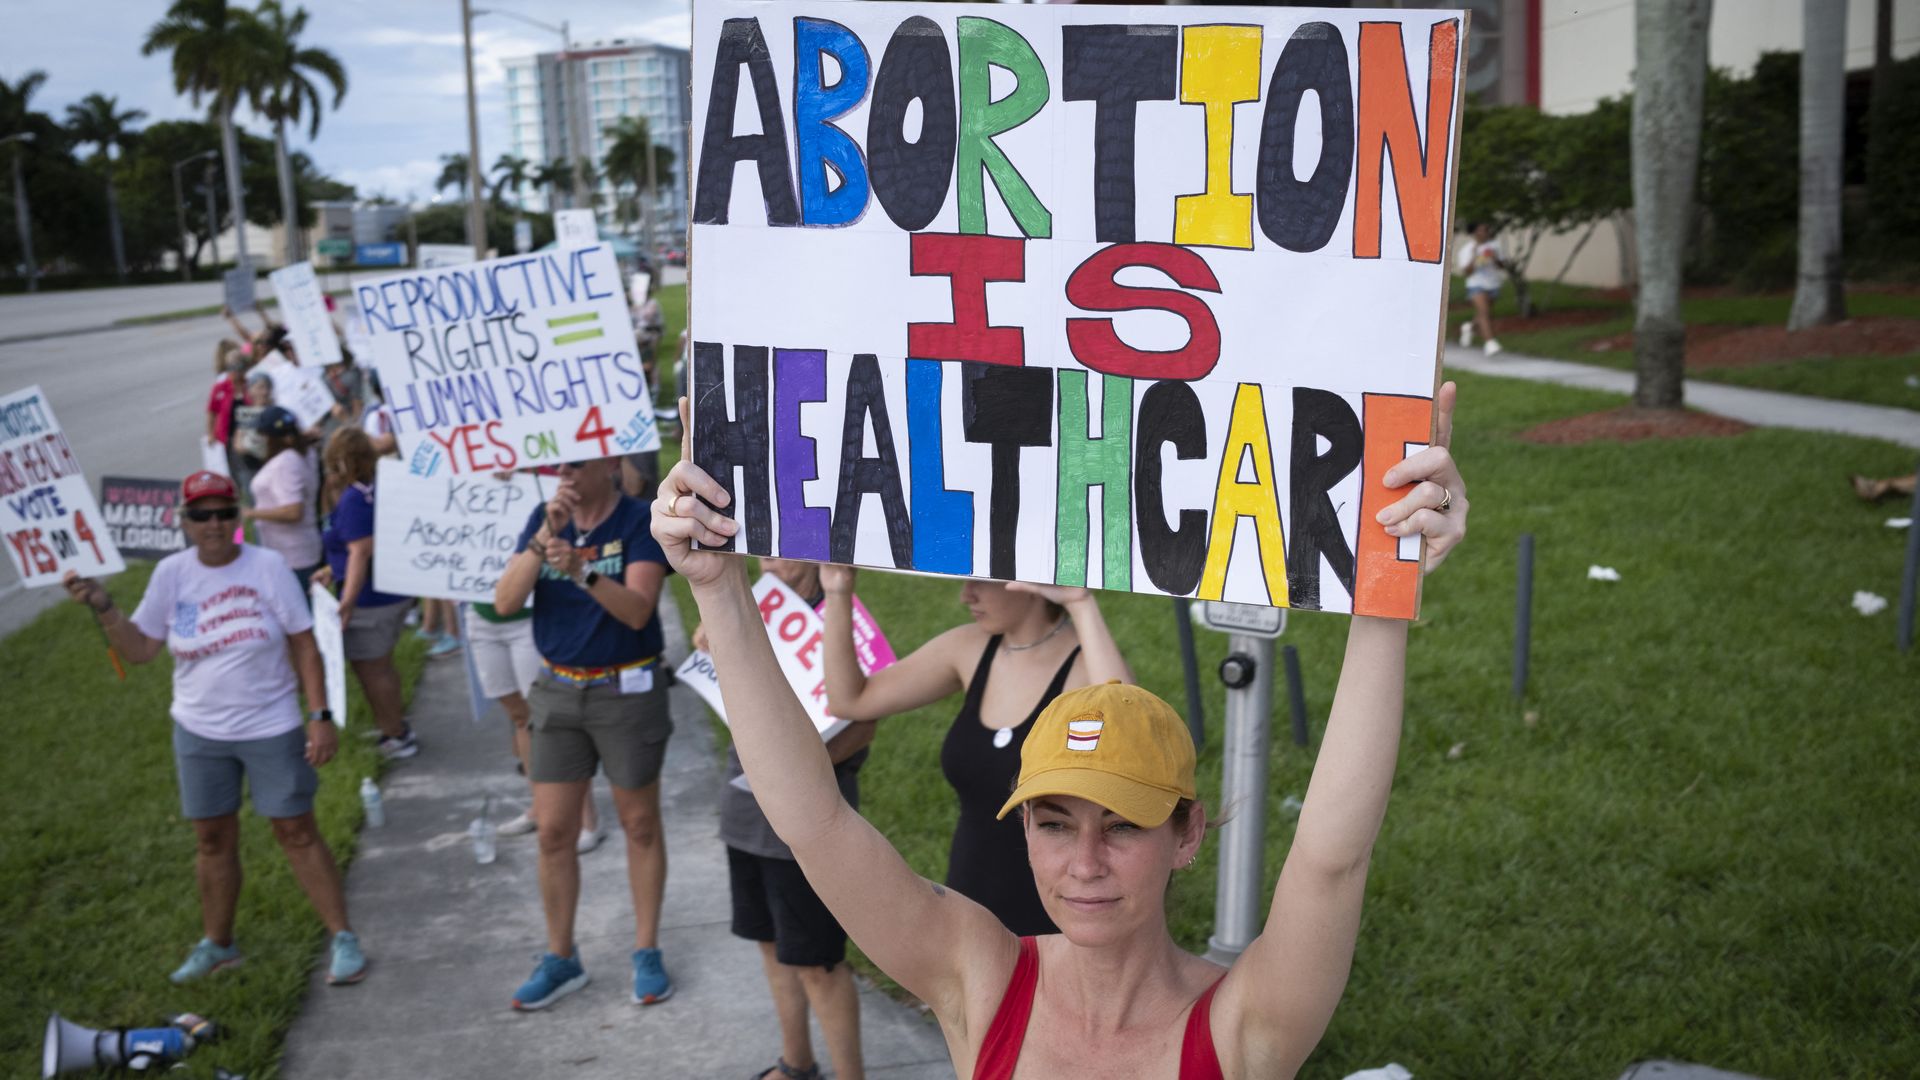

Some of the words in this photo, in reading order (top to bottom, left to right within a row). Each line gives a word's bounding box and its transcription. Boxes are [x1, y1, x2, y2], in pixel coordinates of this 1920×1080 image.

[692, 14, 1460, 264] ABORTION
[358, 246, 613, 335] REPRODUCTIVE
[907, 232, 1222, 381] IS
[404, 312, 540, 380] RIGHTS
[385, 370, 503, 434] HUMAN
[506, 352, 643, 417] RIGHTS
[430, 421, 517, 474] YES
[524, 430, 559, 459] ON
[575, 406, 615, 457] 4
[8, 485, 67, 520] VOTE
[443, 478, 524, 517] KEEP
[692, 340, 1433, 620] HEALTHCARE
[6, 526, 58, 578] YES
[74, 509, 105, 565] 4
[403, 517, 515, 552] ABORTIO
[758, 587, 824, 671] ROE
